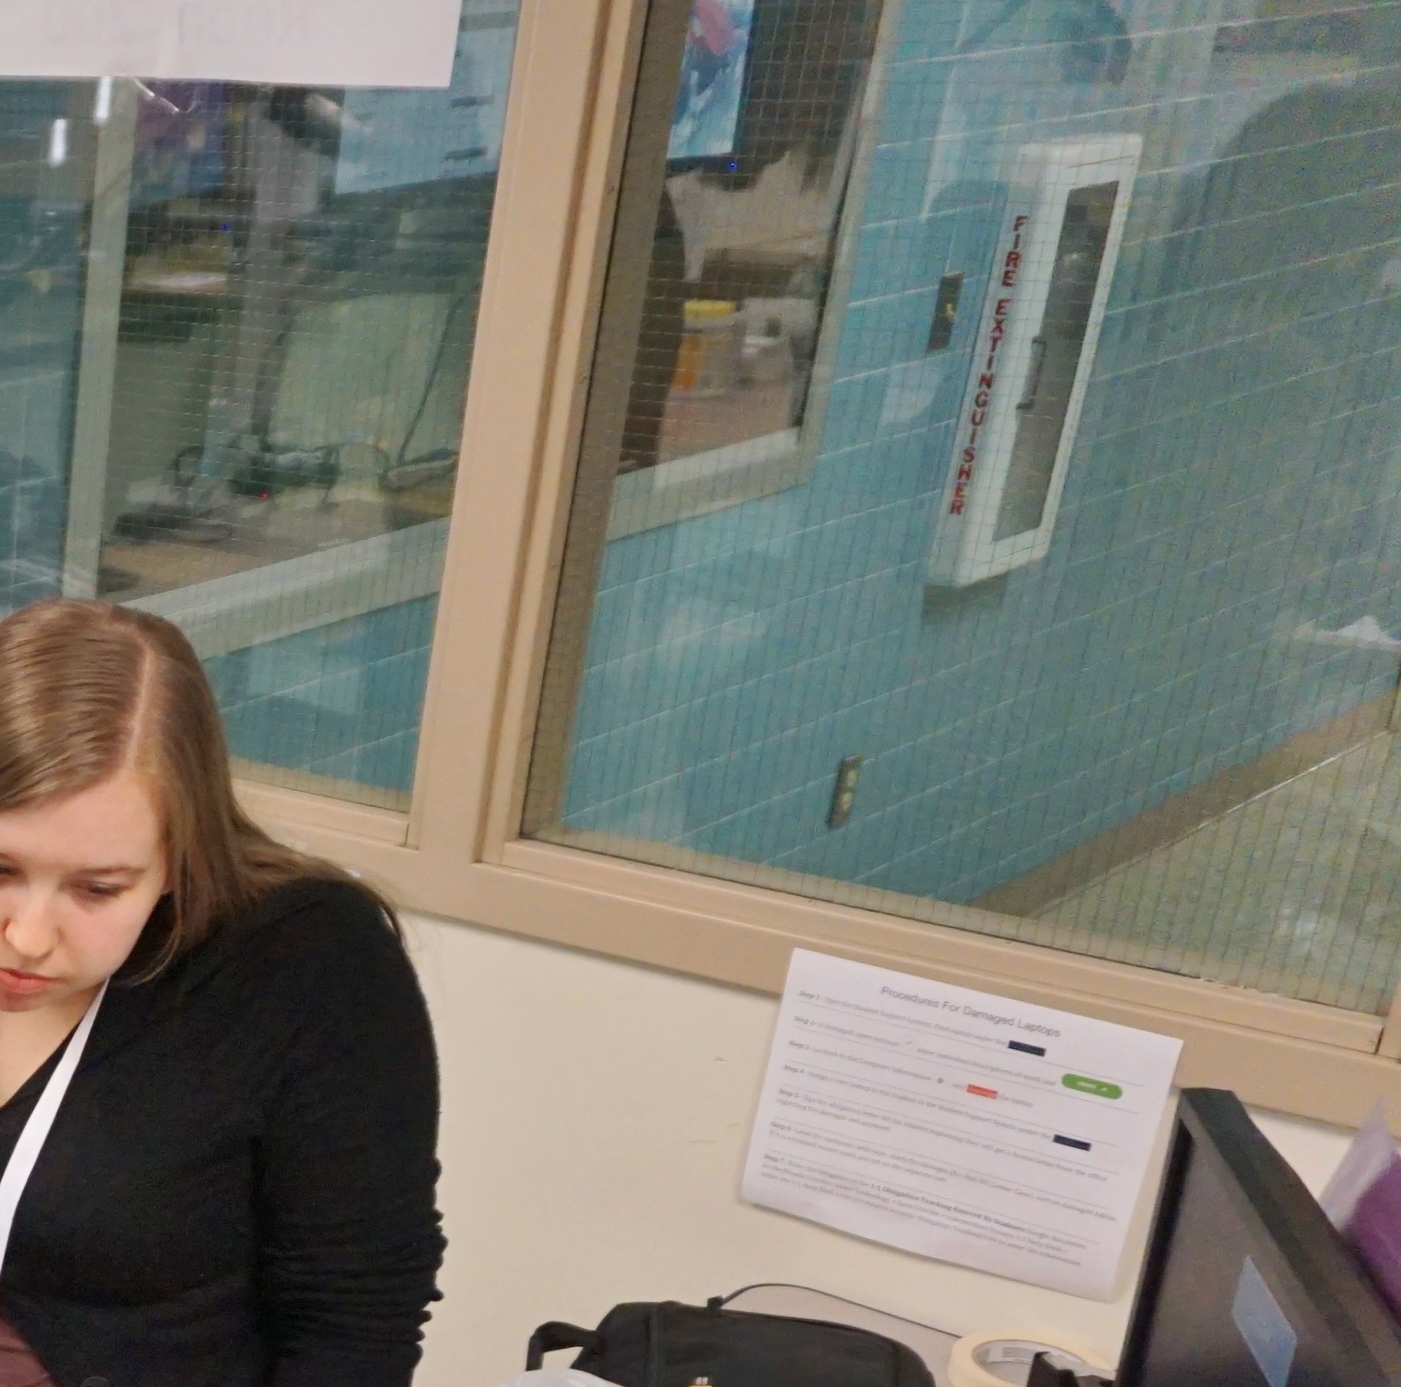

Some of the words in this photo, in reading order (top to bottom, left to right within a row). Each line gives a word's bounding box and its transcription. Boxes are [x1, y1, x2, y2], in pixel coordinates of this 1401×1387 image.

[1002, 215, 1028, 288] FIRE
[949, 298, 1012, 516] EXTINGUISHER
[880, 985, 939, 1009] Procedures
[942, 1000, 961, 1013] For
[962, 1005, 1015, 1028] Damaged
[1016, 1018, 1061, 1039] Laptops
